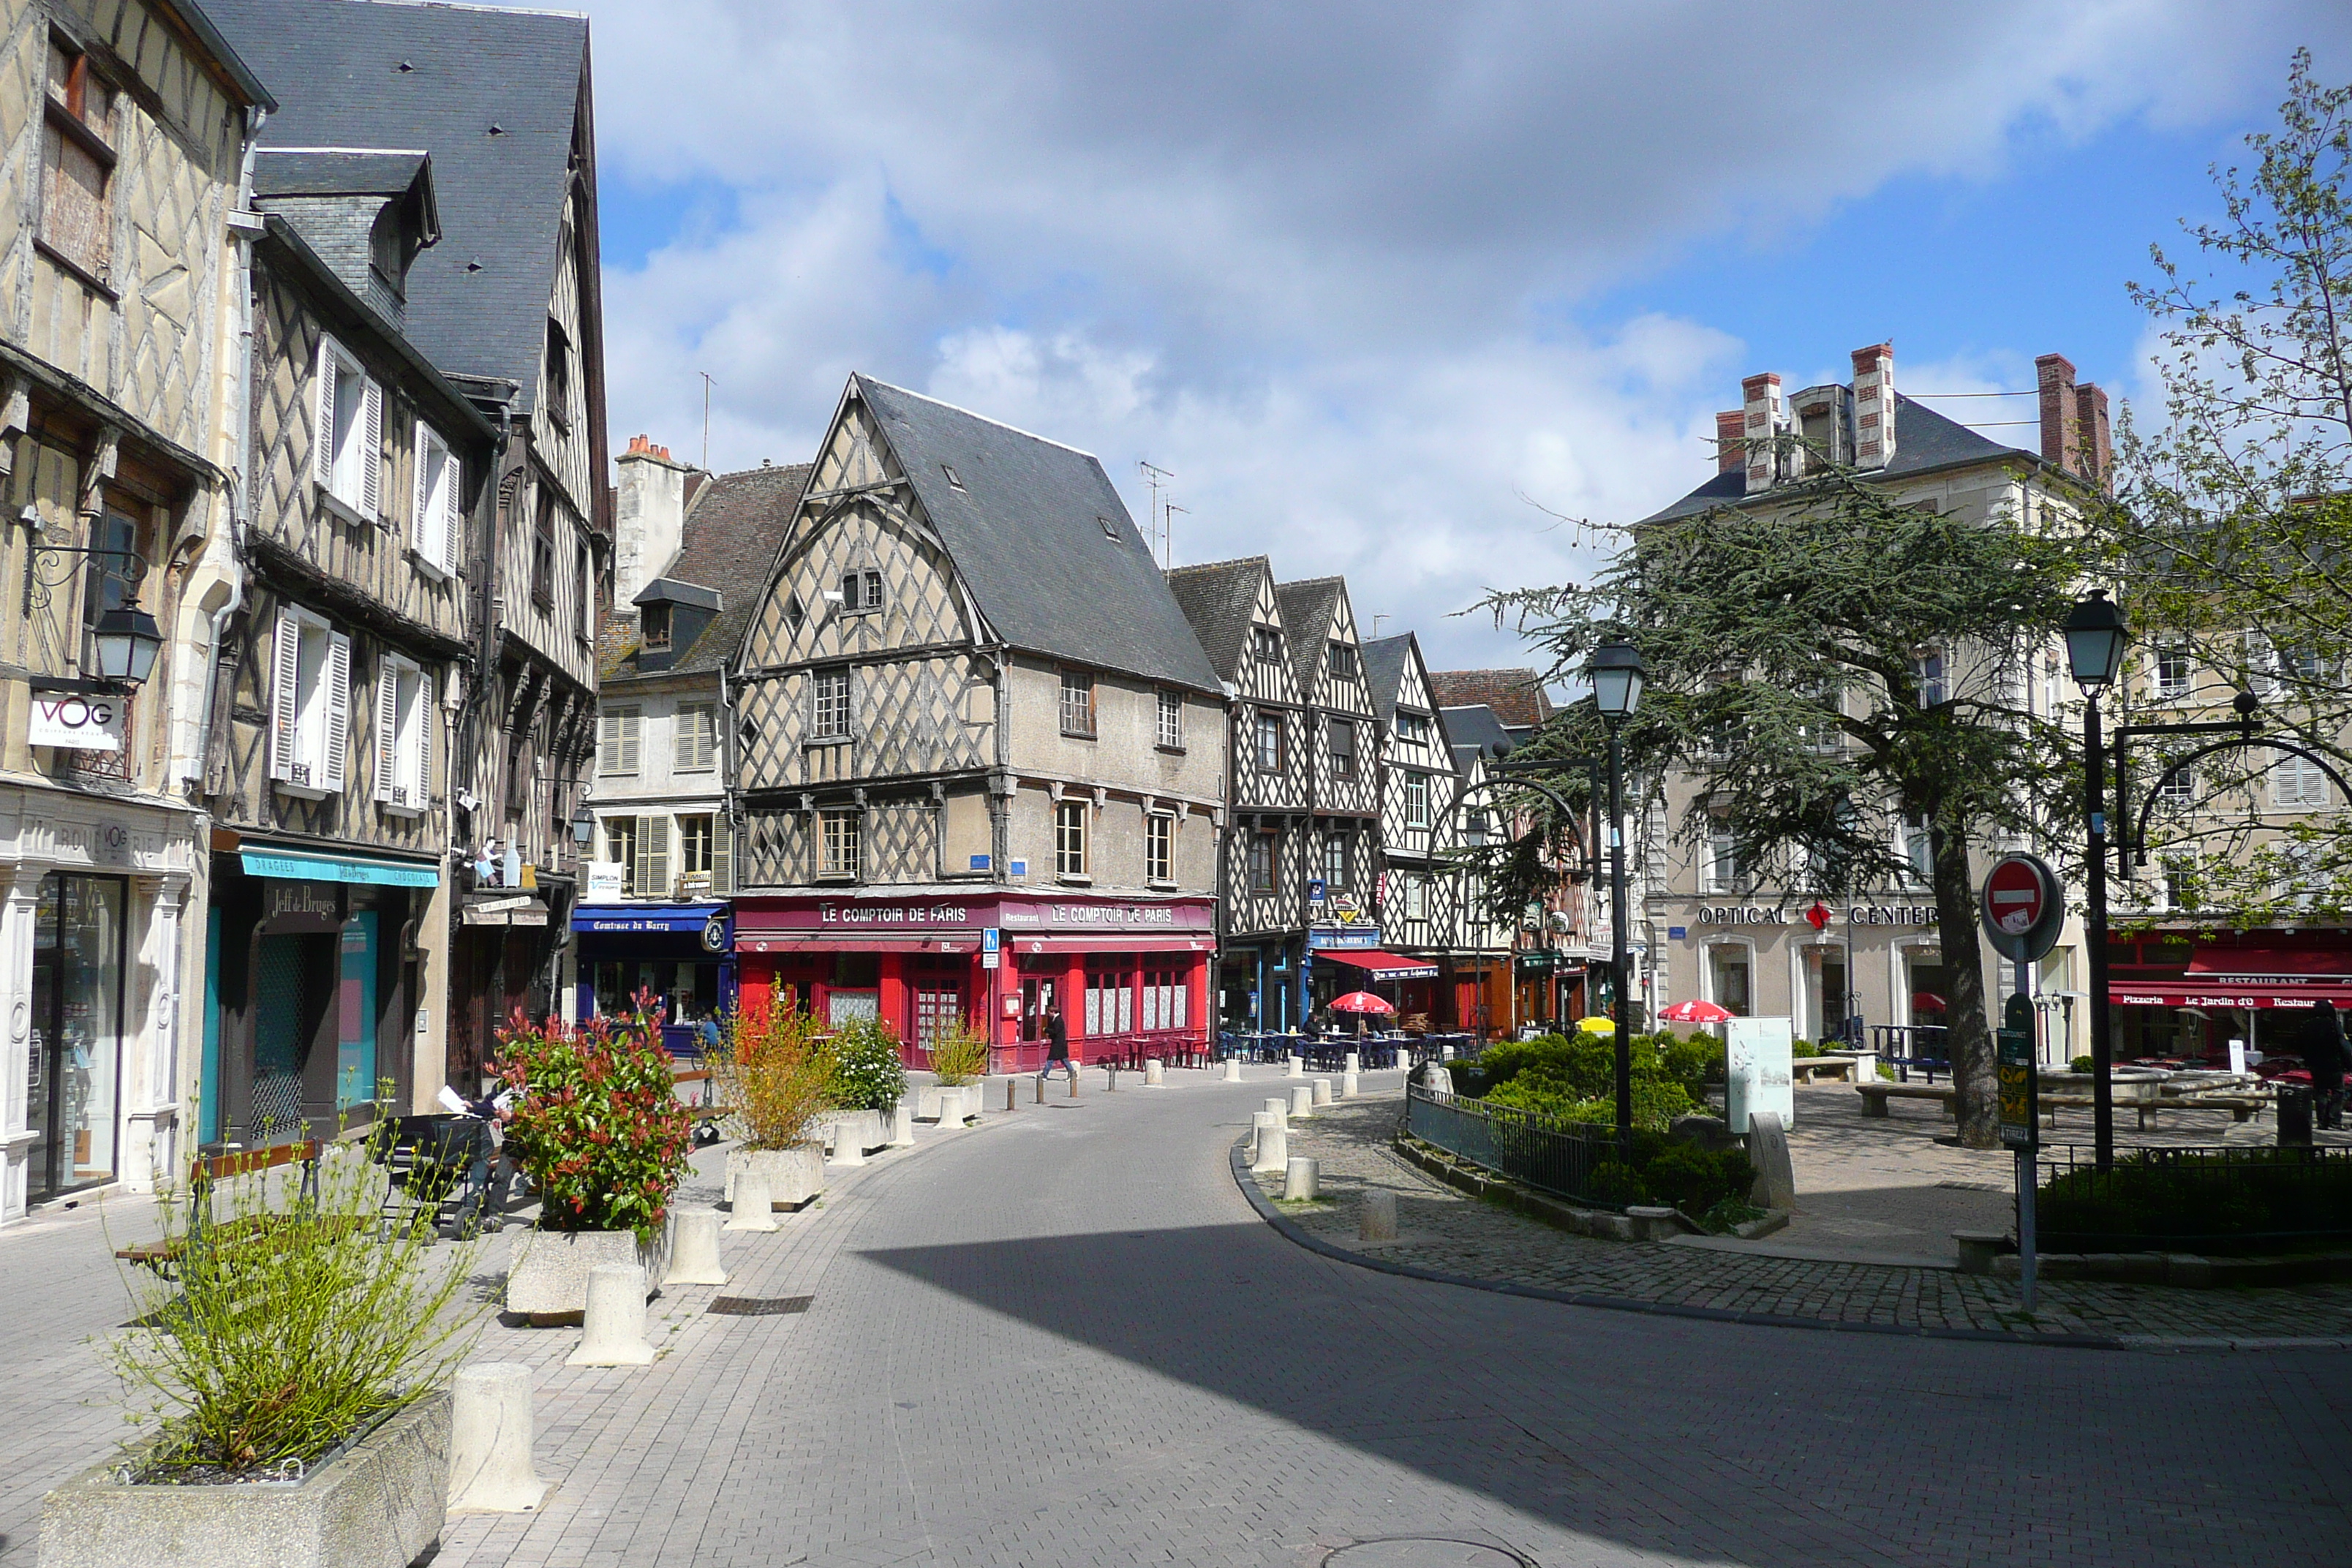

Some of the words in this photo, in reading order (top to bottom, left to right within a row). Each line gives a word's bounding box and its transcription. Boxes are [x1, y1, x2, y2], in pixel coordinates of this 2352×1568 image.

[39, 697, 113, 728] VOG
[104, 826, 127, 847] VOG
[1375, 873, 1384, 905] TABAC
[272, 889, 293, 917] Jeff
[293, 901, 301, 912] de
[303, 886, 336, 920] Bruges
[823, 908, 837, 922] LE
[843, 908, 903, 922] COMPTOIR
[909, 908, 925, 922] DE
[930, 908, 966, 922] PARIS
[1006, 913, 1039, 922] Restaurant
[1052, 908, 1066, 922] LE
[1071, 907, 1123, 923] COMPTOIR
[1127, 907, 1140, 923] DE
[1145, 908, 1172, 923] PARIS
[1697, 906, 1787, 924] OPTICAL
[1850, 906, 1938, 924] CENTER
[593, 921, 630, 930] Comtesse
[633, 921, 642, 930] du
[646, 920, 670, 932] Barry
[2123, 995, 2163, 1004] Pizzeria
[2185, 996, 2198, 1005] Le
[2201, 997, 2234, 1006] Jardin
